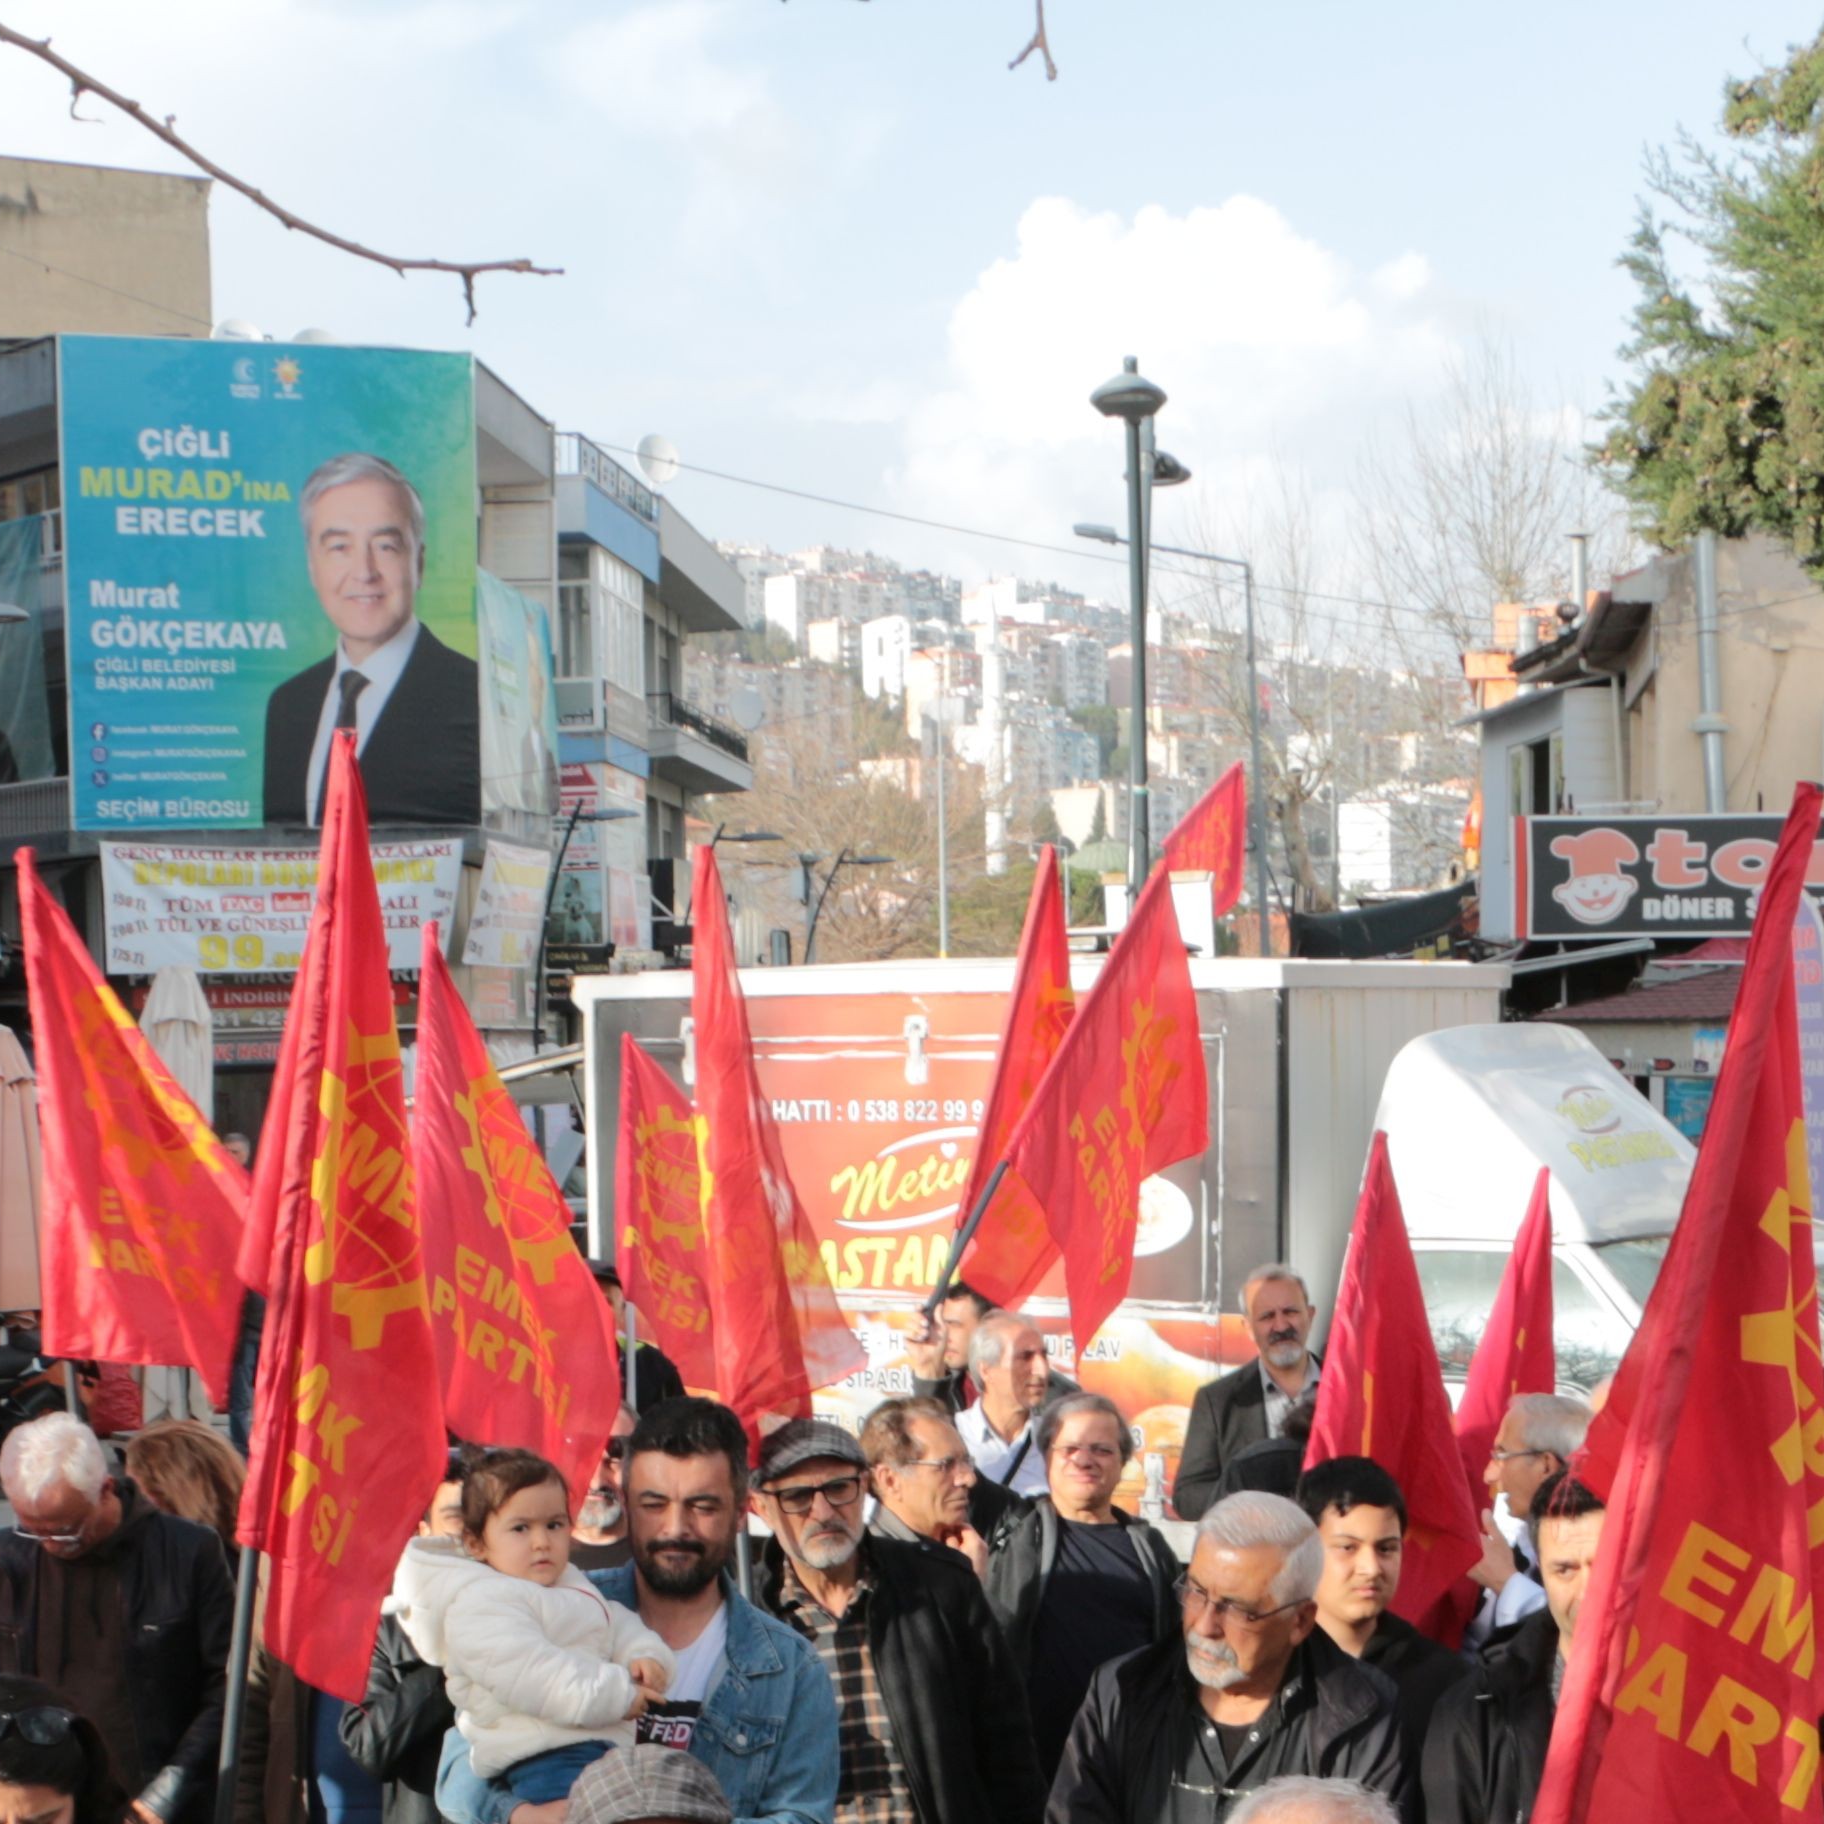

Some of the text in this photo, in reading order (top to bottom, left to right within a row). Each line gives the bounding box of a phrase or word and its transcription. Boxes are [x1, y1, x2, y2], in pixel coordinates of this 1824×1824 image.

[115, 506, 267, 539] ERECEK
[88, 579, 180, 609] Murat
[90, 615, 288, 655] GÖKÇEKAYA
[141, 656, 237, 674] BELEDİYESİ
[94, 676, 215, 693] BAŞKAN ADAYI
[96, 797, 251, 821] SEÇİM BÜROSU
[112, 845, 164, 863] GENÇ
[164, 892, 214, 913] TÜM
[1642, 890, 1735, 921] DÖNER
[155, 917, 195, 932] TÜL
[198, 918, 222, 932] VE
[772, 1100, 831, 1122] HATTI
[848, 1101, 861, 1121] 0
[864, 1100, 899, 1121] 538
[904, 1100, 939, 1121] 822
[943, 1101, 967, 1121] 99
